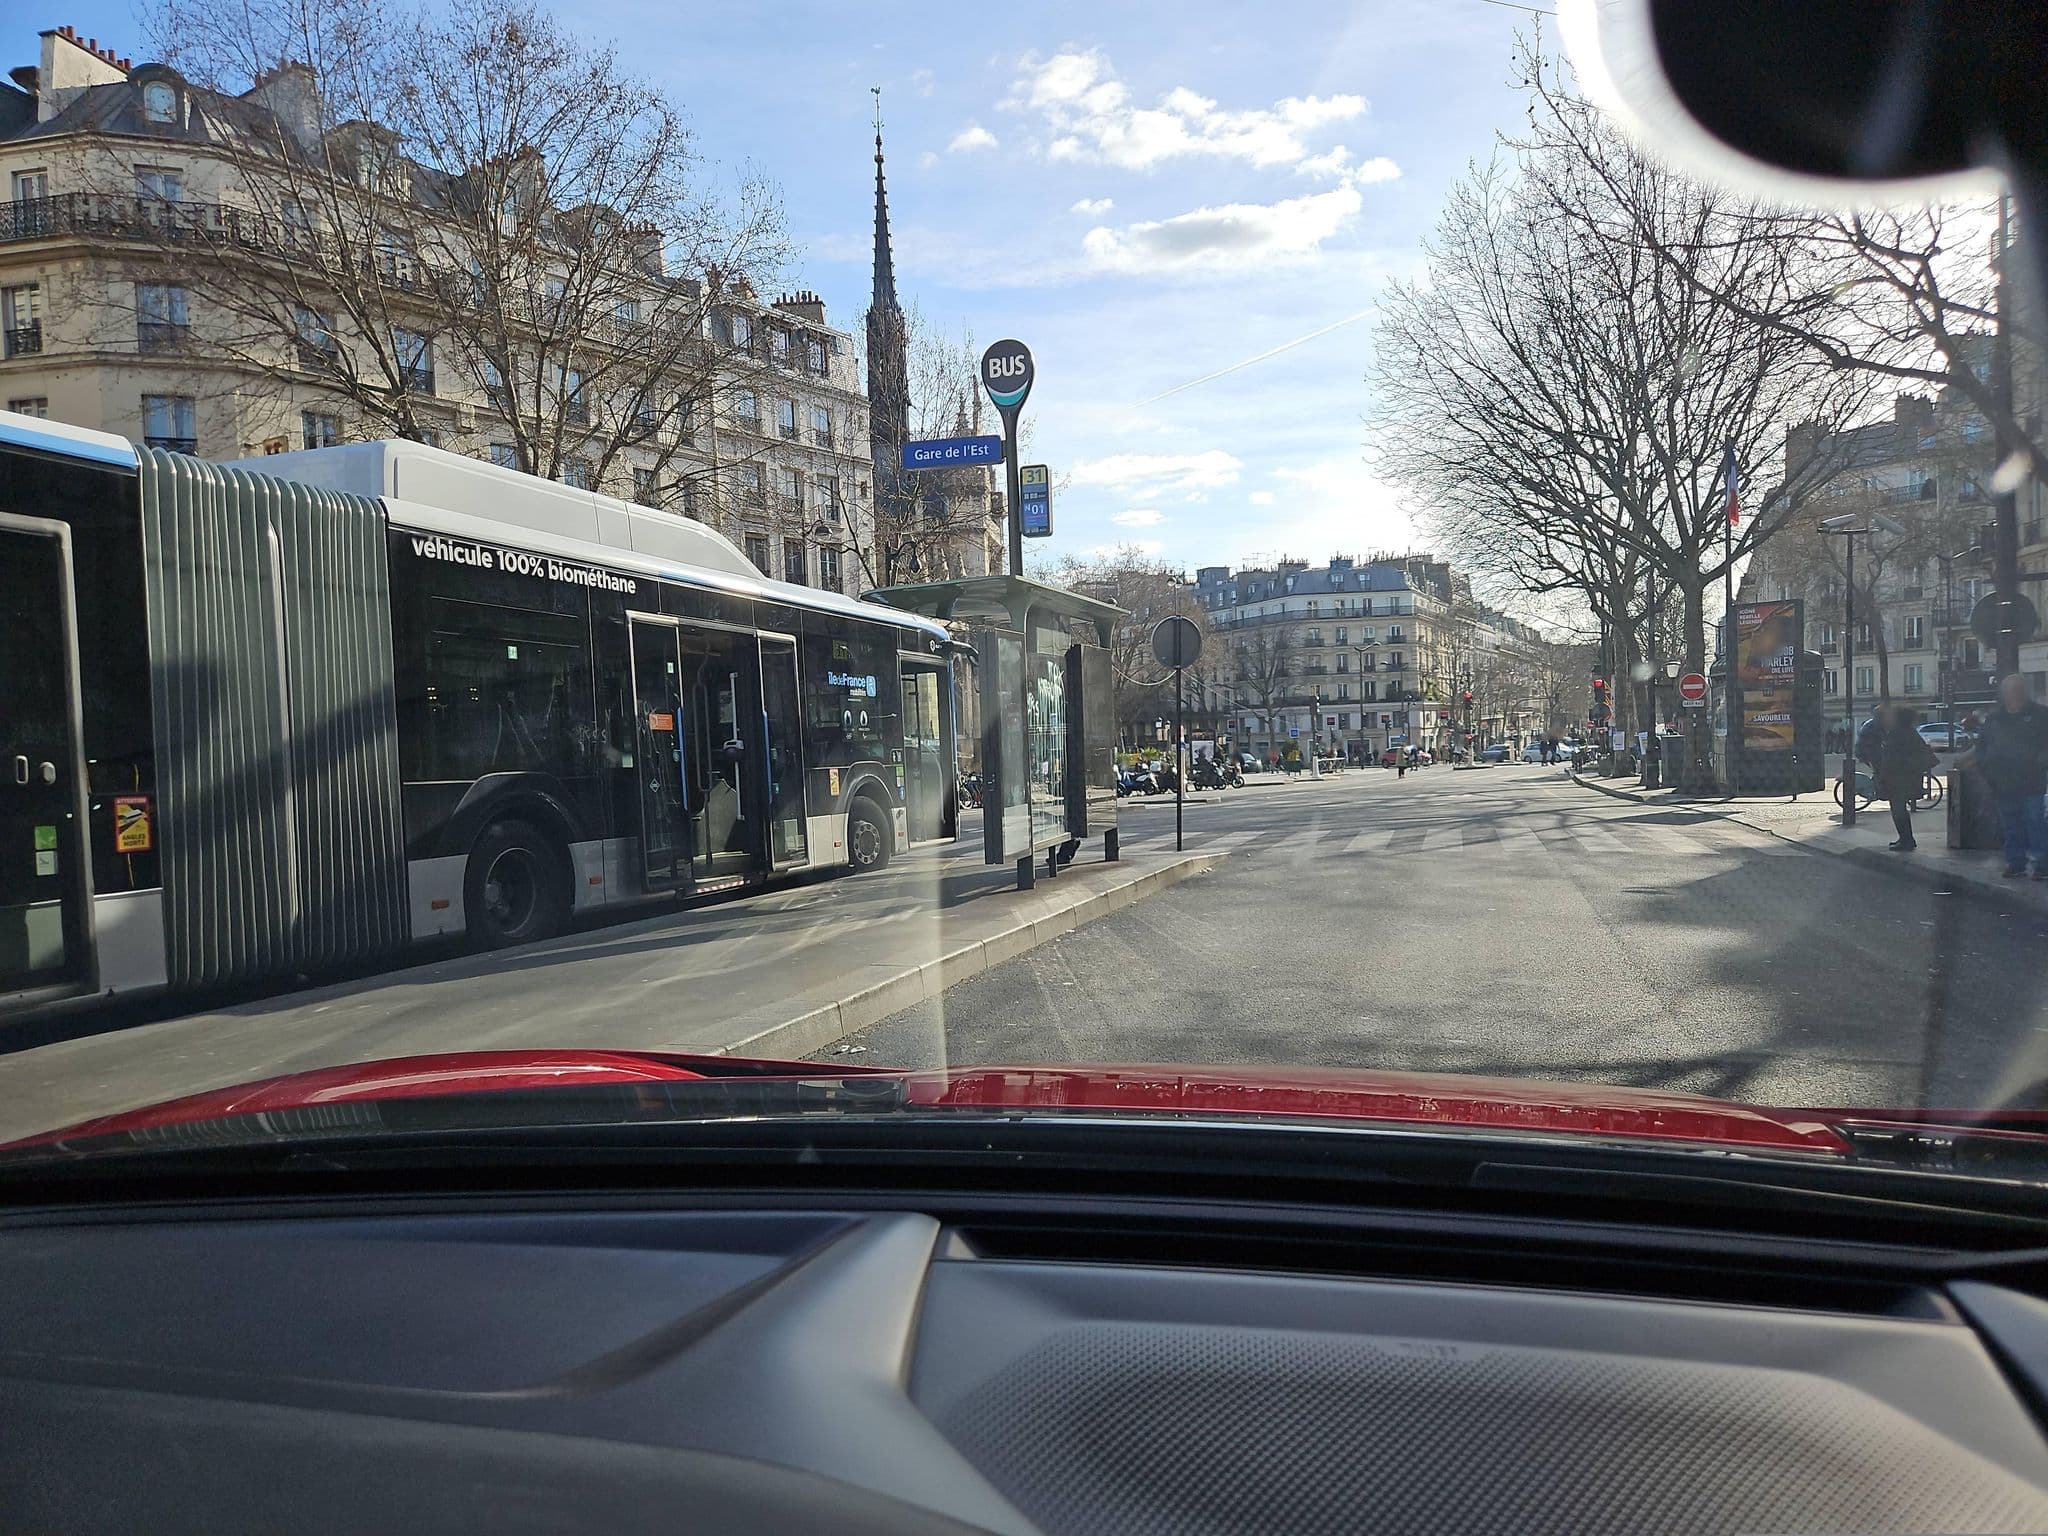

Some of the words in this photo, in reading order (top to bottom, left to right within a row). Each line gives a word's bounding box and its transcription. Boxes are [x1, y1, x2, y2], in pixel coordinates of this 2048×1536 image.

[989, 355, 1026, 378] BUS
[914, 449, 942, 460] Gare
[945, 447, 959, 458] de
[963, 445, 989, 457] l'Est
[1026, 469, 1042, 483] 31
[412, 536, 493, 568] véhicule
[497, 550, 545, 578] 100%
[549, 561, 637, 594] biométhane
[1753, 714, 1791, 722] SAVOUREUX
